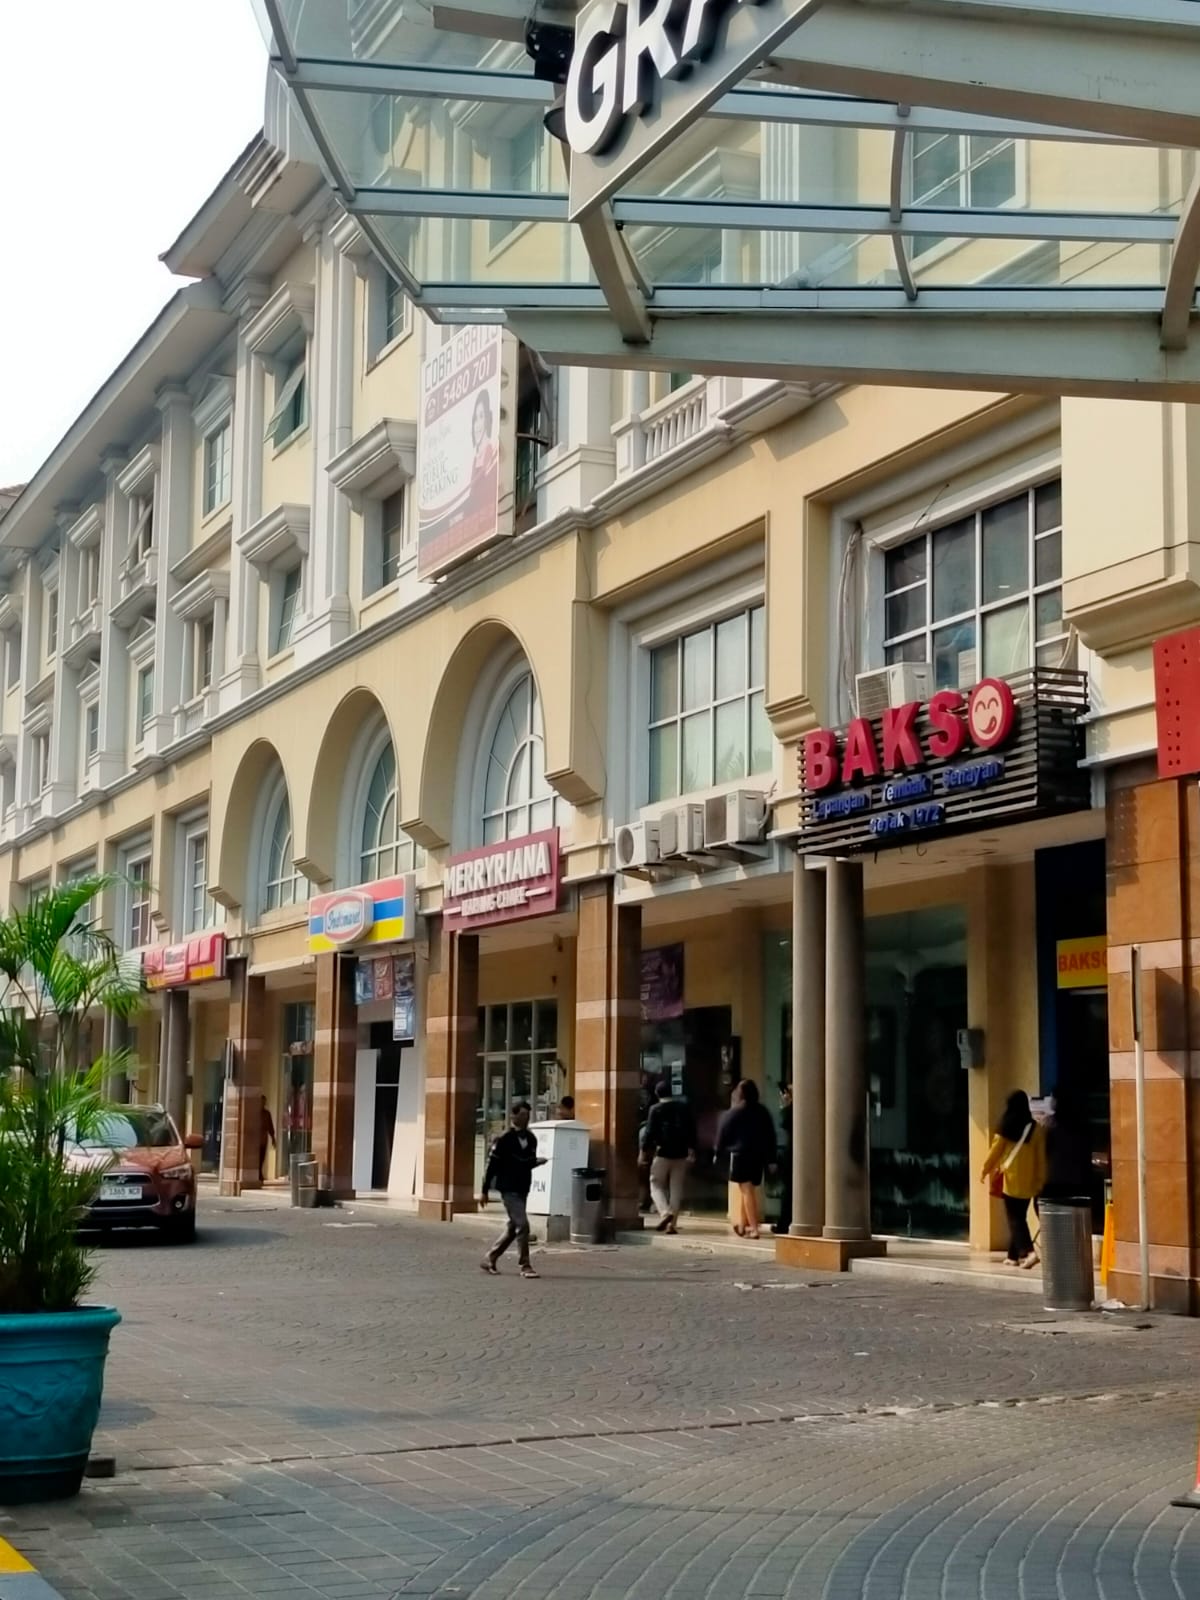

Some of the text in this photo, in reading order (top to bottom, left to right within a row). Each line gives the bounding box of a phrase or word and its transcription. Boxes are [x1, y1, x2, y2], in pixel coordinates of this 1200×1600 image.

[425, 346, 453, 393] COBA
[442, 351, 491, 409] 5480 701
[911, 805, 943, 827] 1972
